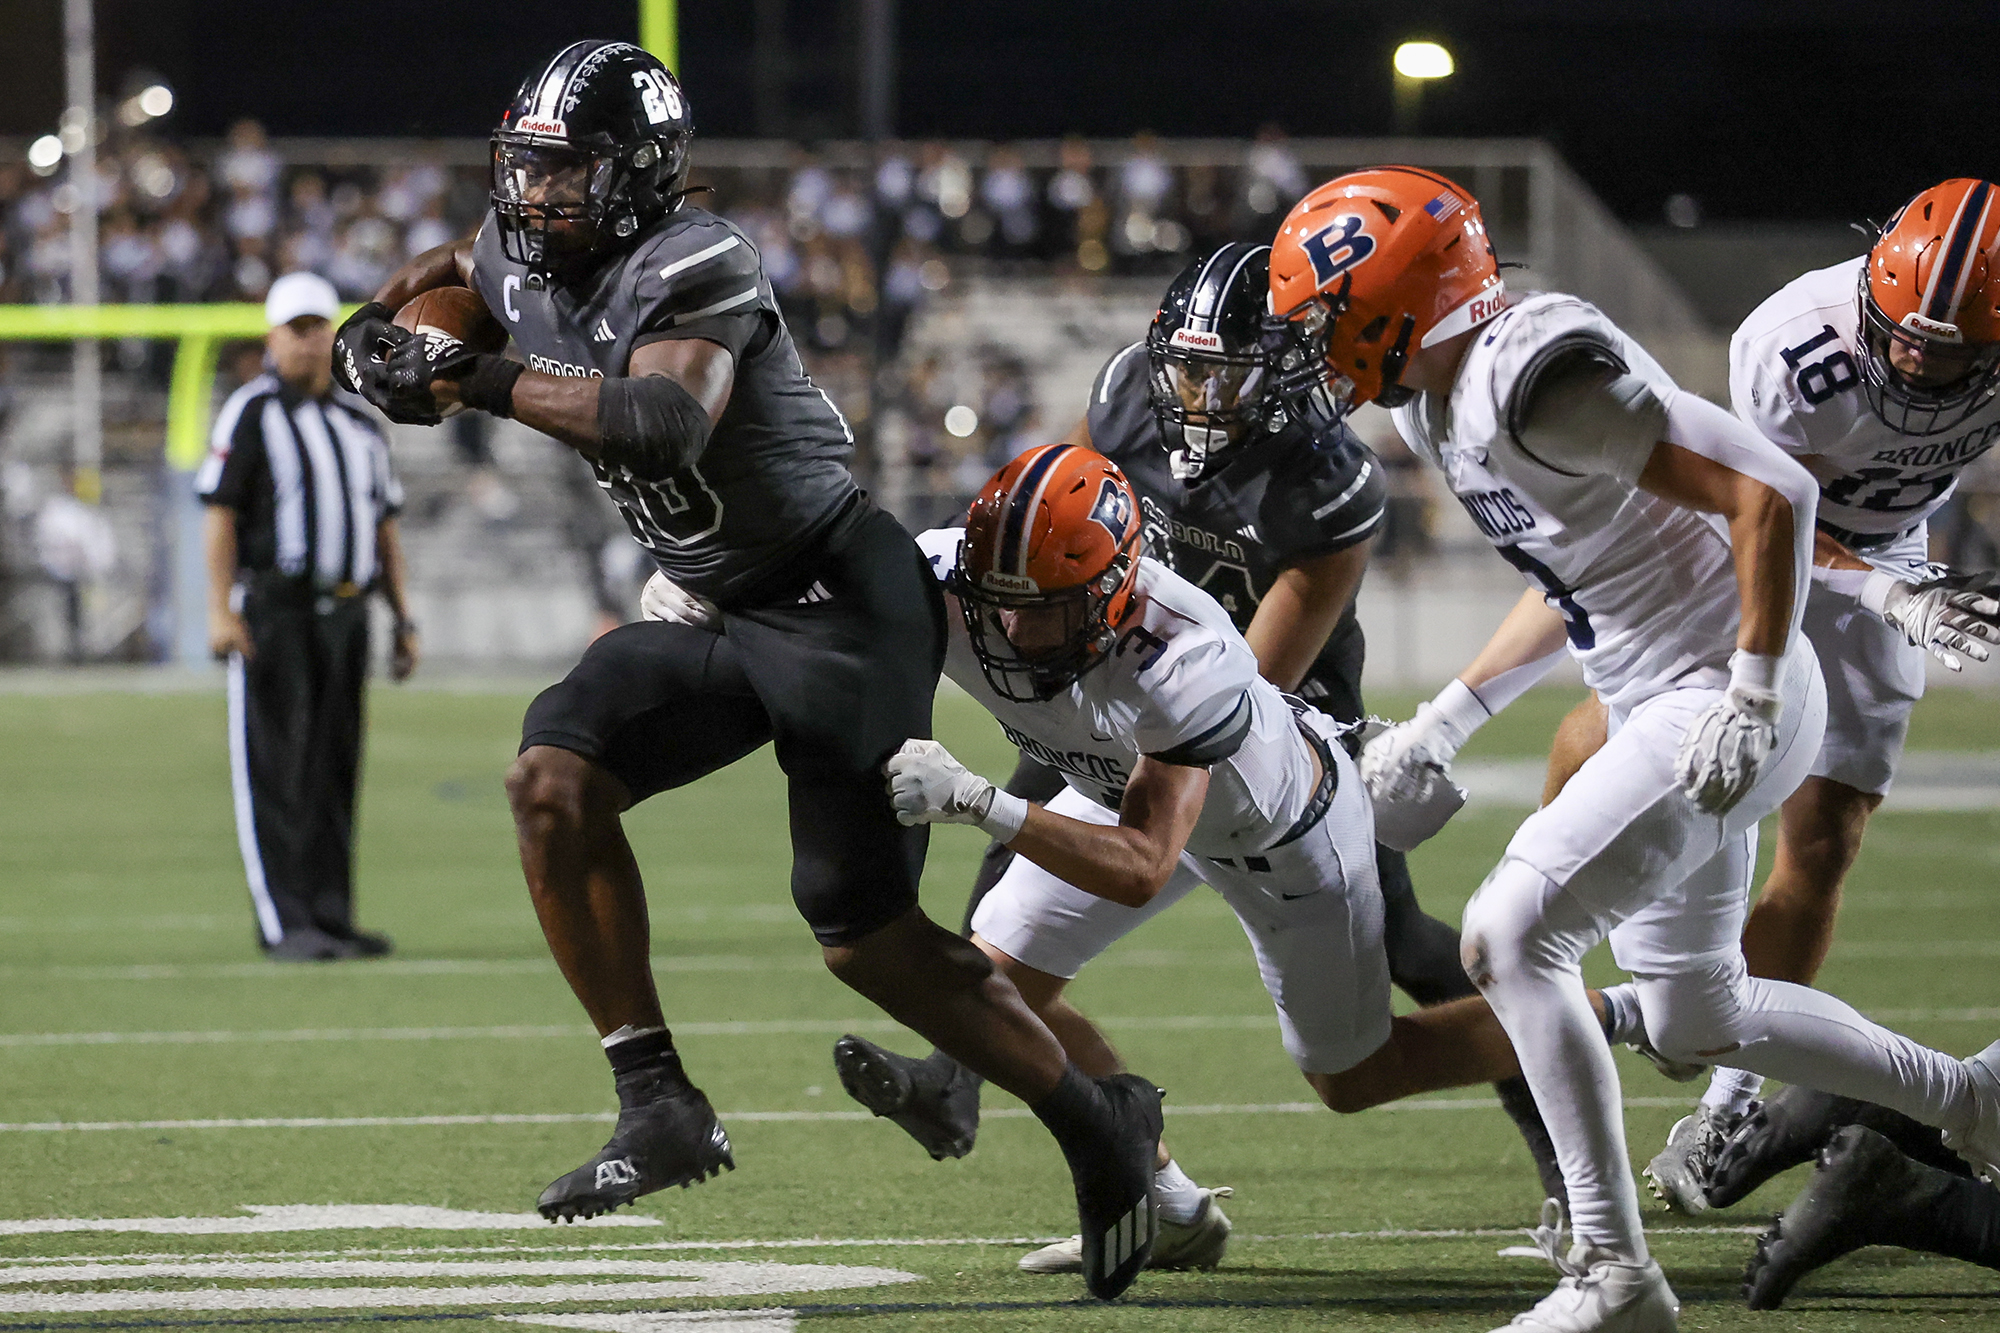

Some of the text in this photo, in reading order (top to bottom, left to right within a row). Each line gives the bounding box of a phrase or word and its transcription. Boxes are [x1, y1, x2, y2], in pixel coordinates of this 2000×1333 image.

[631, 67, 684, 126] 28
[521, 119, 562, 134] Riddell
[1299, 213, 1378, 291] B
[503, 274, 521, 323] C
[1177, 331, 1218, 347] Riddell
[1779, 323, 1859, 406] 18
[1086, 476, 1134, 551] B
[986, 574, 1031, 591] Riddell
[1115, 625, 1170, 673] 3
